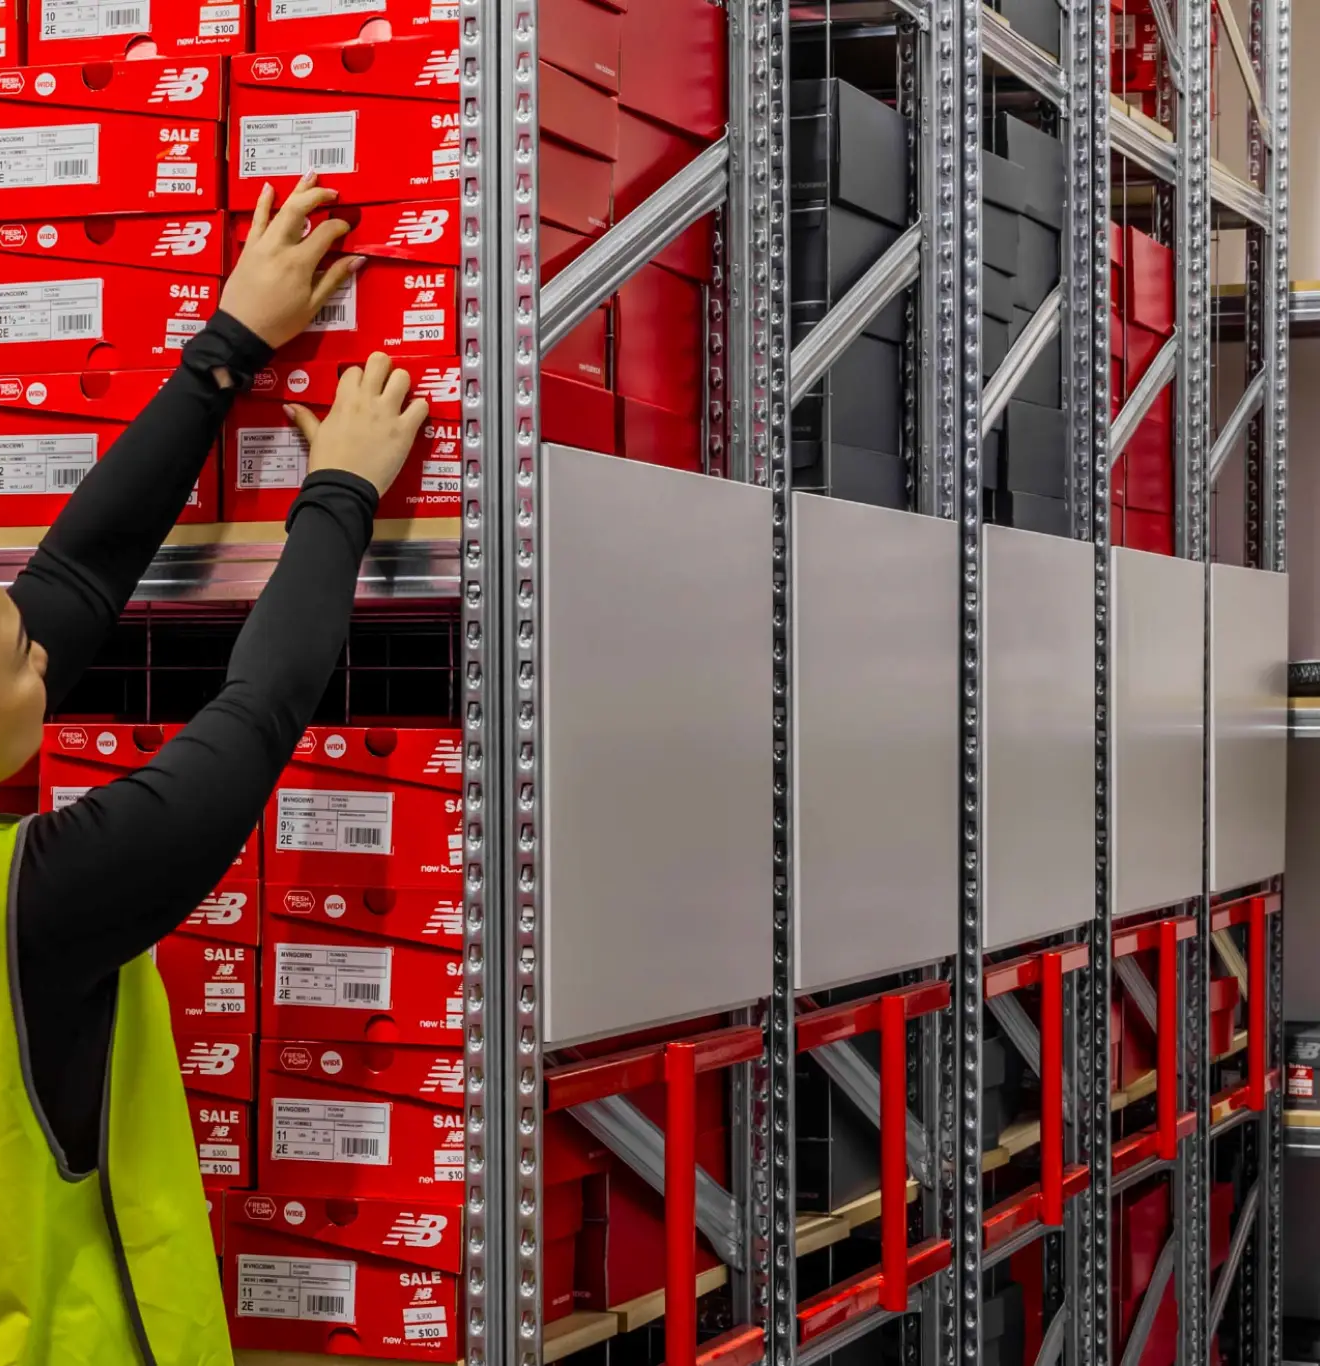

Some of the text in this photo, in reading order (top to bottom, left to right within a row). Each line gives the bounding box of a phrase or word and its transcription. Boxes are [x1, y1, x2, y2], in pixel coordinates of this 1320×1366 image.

[275, 4, 287, 14] 2E
[447, 10, 460, 18] $10
[45, 12, 55, 22] 10
[45, 25, 56, 34] 2E
[214, 25, 234, 34] $100
[148, 67, 208, 103] NB
[431, 115, 459, 128] SAL
[159, 129, 200, 142] SALE
[169, 144, 189, 155] NB
[245, 148, 256, 158] 12
[244, 162, 256, 172] 2E
[171, 182, 191, 191] $100
[386, 209, 449, 246] NB
[151, 222, 211, 256] NB
[404, 274, 445, 288] SALE
[170, 284, 209, 298] SALE
[415, 291, 435, 302] NB
[179, 301, 199, 312] NB
[419, 330, 439, 339] $100
[435, 441, 455, 453] NB
[242, 460, 253, 469] 12
[242, 473, 253, 483] 2E
[437, 482, 458, 491] $100
[280, 835, 292, 845] 2E
[186, 892, 247, 924] NB
[204, 948, 244, 961] SALE
[216, 964, 234, 975] NB
[280, 976, 290, 985] 11
[279, 990, 291, 999] 2E
[221, 1003, 240, 1012] $100
[180, 1042, 240, 1075] NB
[200, 1109, 239, 1123] SALE
[433, 1115, 464, 1128] SAL
[211, 1126, 229, 1137] NB
[277, 1130, 287, 1140] 11
[276, 1144, 288, 1154] 2E
[213, 1164, 232, 1173] $100
[286, 1209, 304, 1217] WIDE
[382, 1212, 448, 1247] NB
[400, 1272, 442, 1287] SALE
[242, 1288, 252, 1297] 11
[413, 1287, 433, 1300] NB
[241, 1301, 254, 1311] 2E
[418, 1328, 439, 1337] $100
[383, 1336, 401, 1344] new
